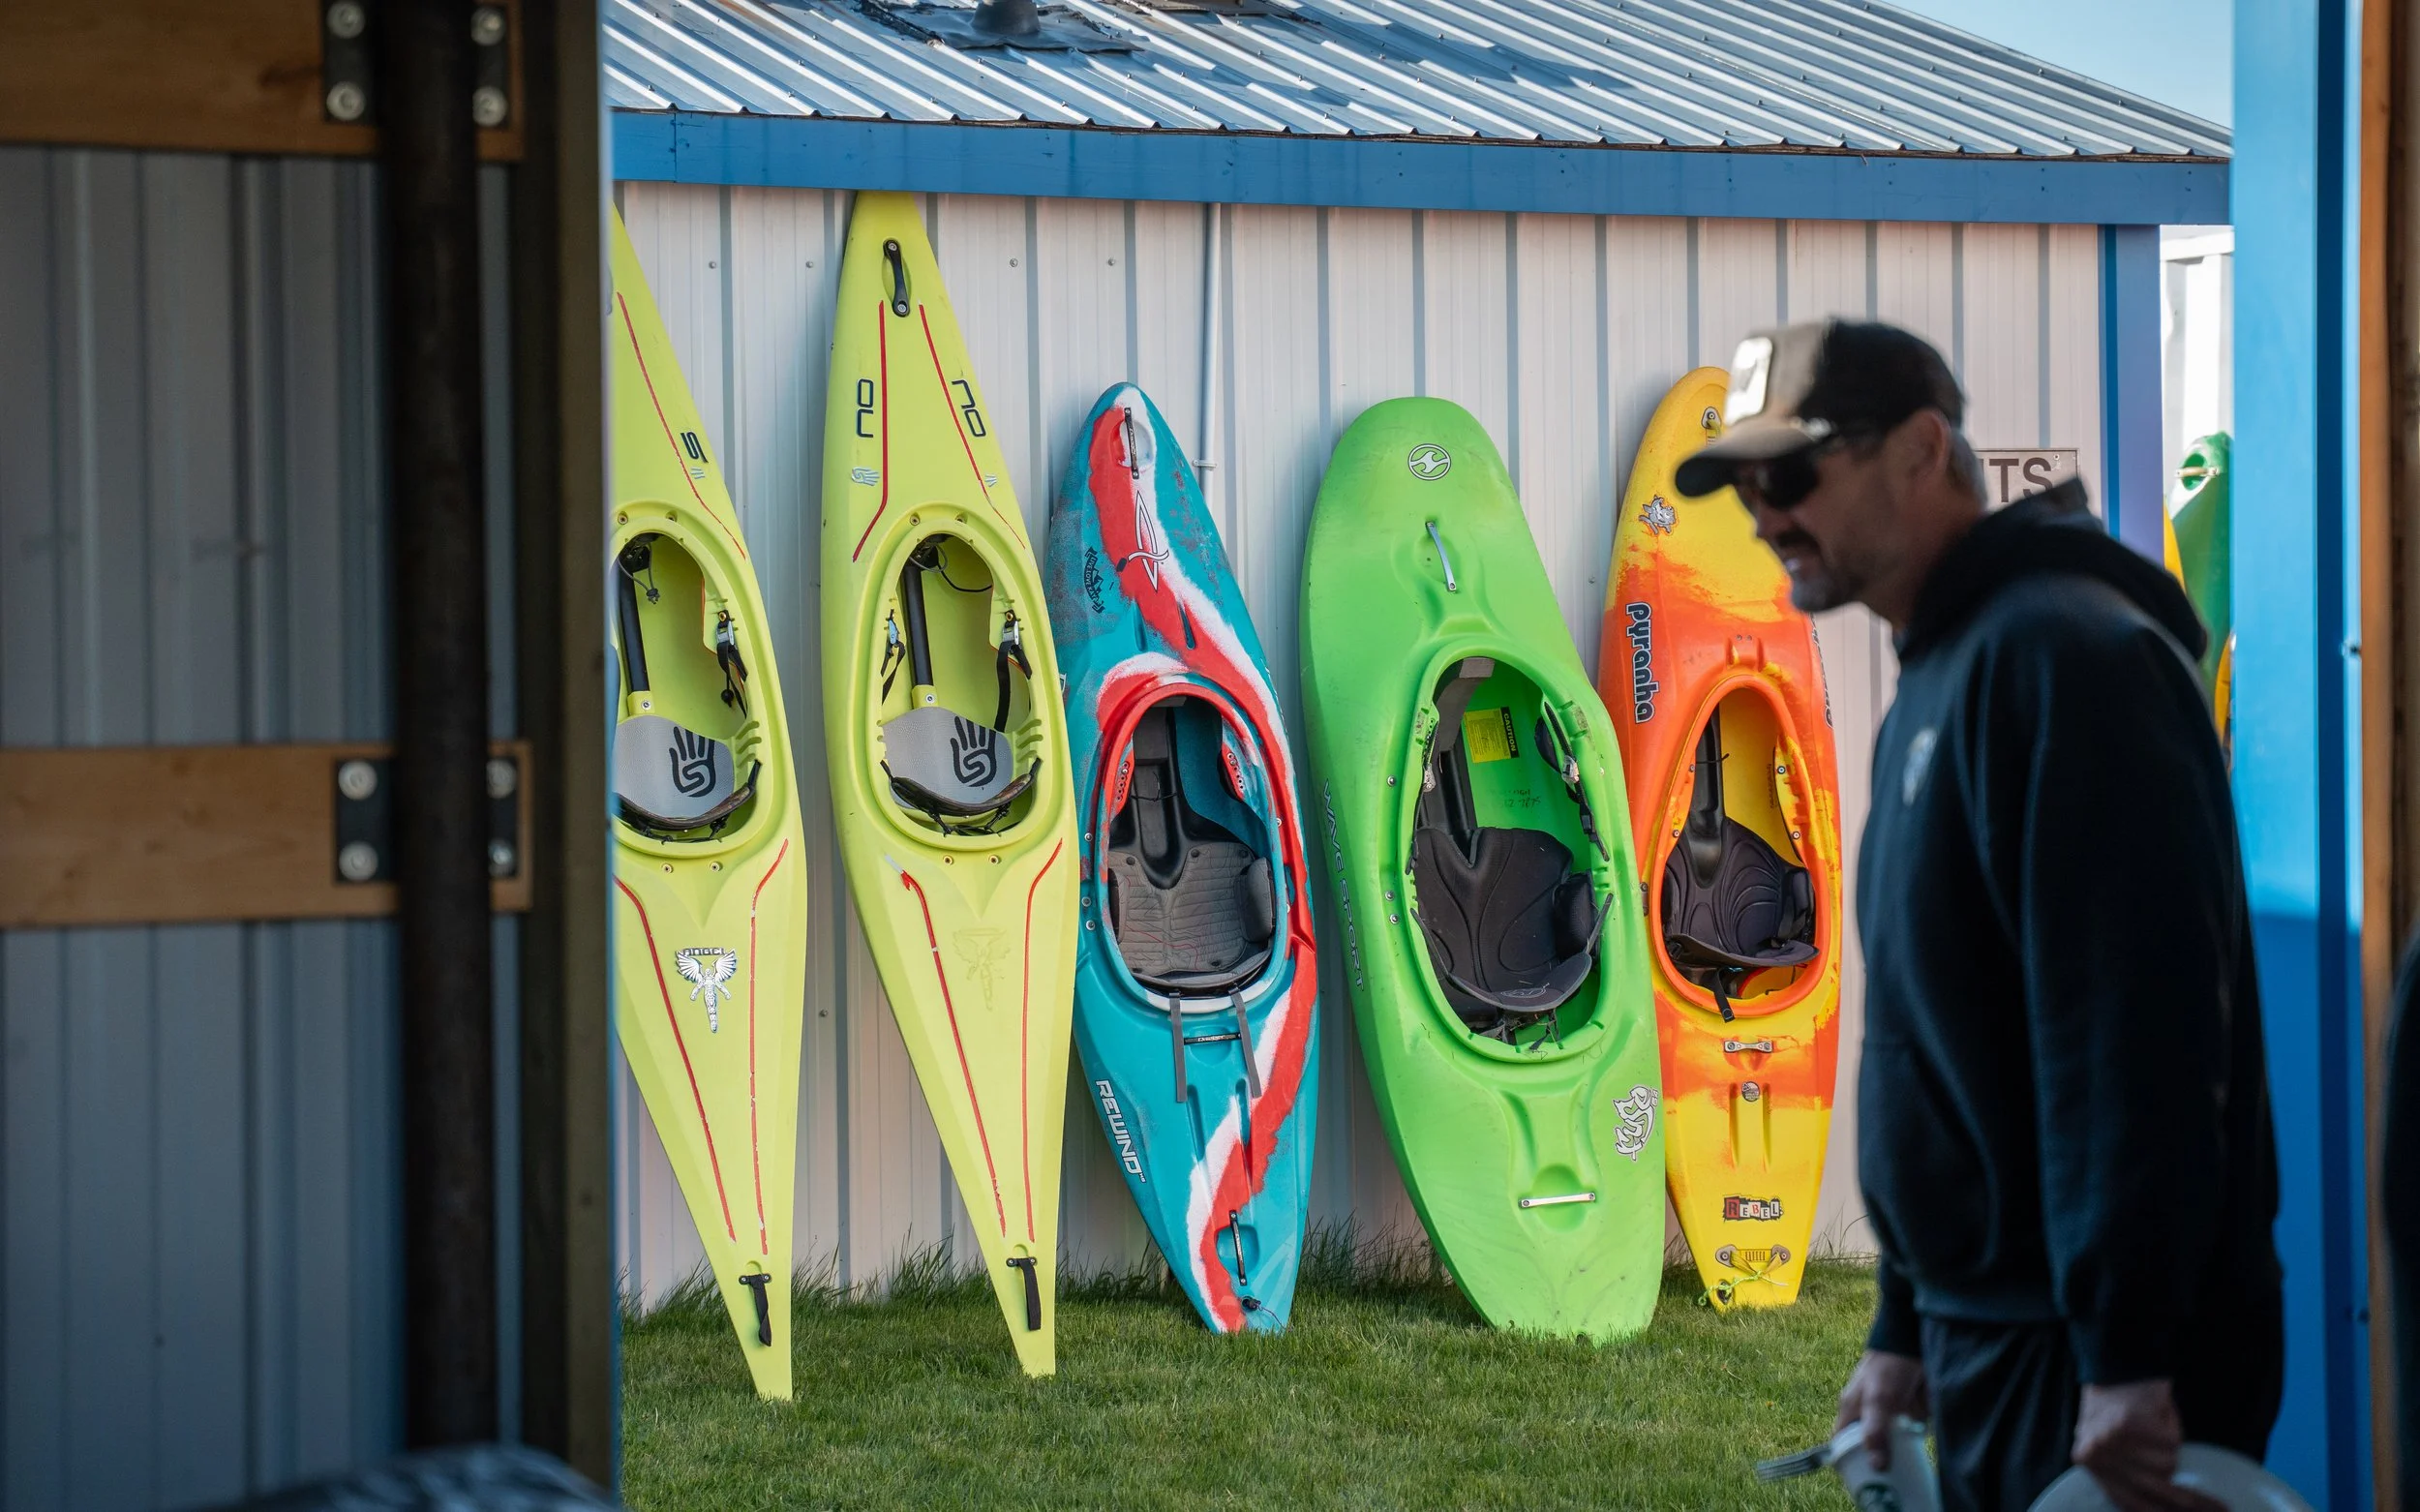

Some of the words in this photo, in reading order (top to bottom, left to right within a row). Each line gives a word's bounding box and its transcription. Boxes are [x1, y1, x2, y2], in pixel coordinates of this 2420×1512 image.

[1978, 457, 2053, 502] TS
[1626, 602, 1660, 724] pyranha
[1503, 712, 1517, 752] CAUTION
[1323, 778, 1345, 873] WAVE
[1339, 877, 1364, 992] SPORT
[1095, 1079, 1143, 1174] REWIND
[1728, 1201, 1778, 1218] REBEL
